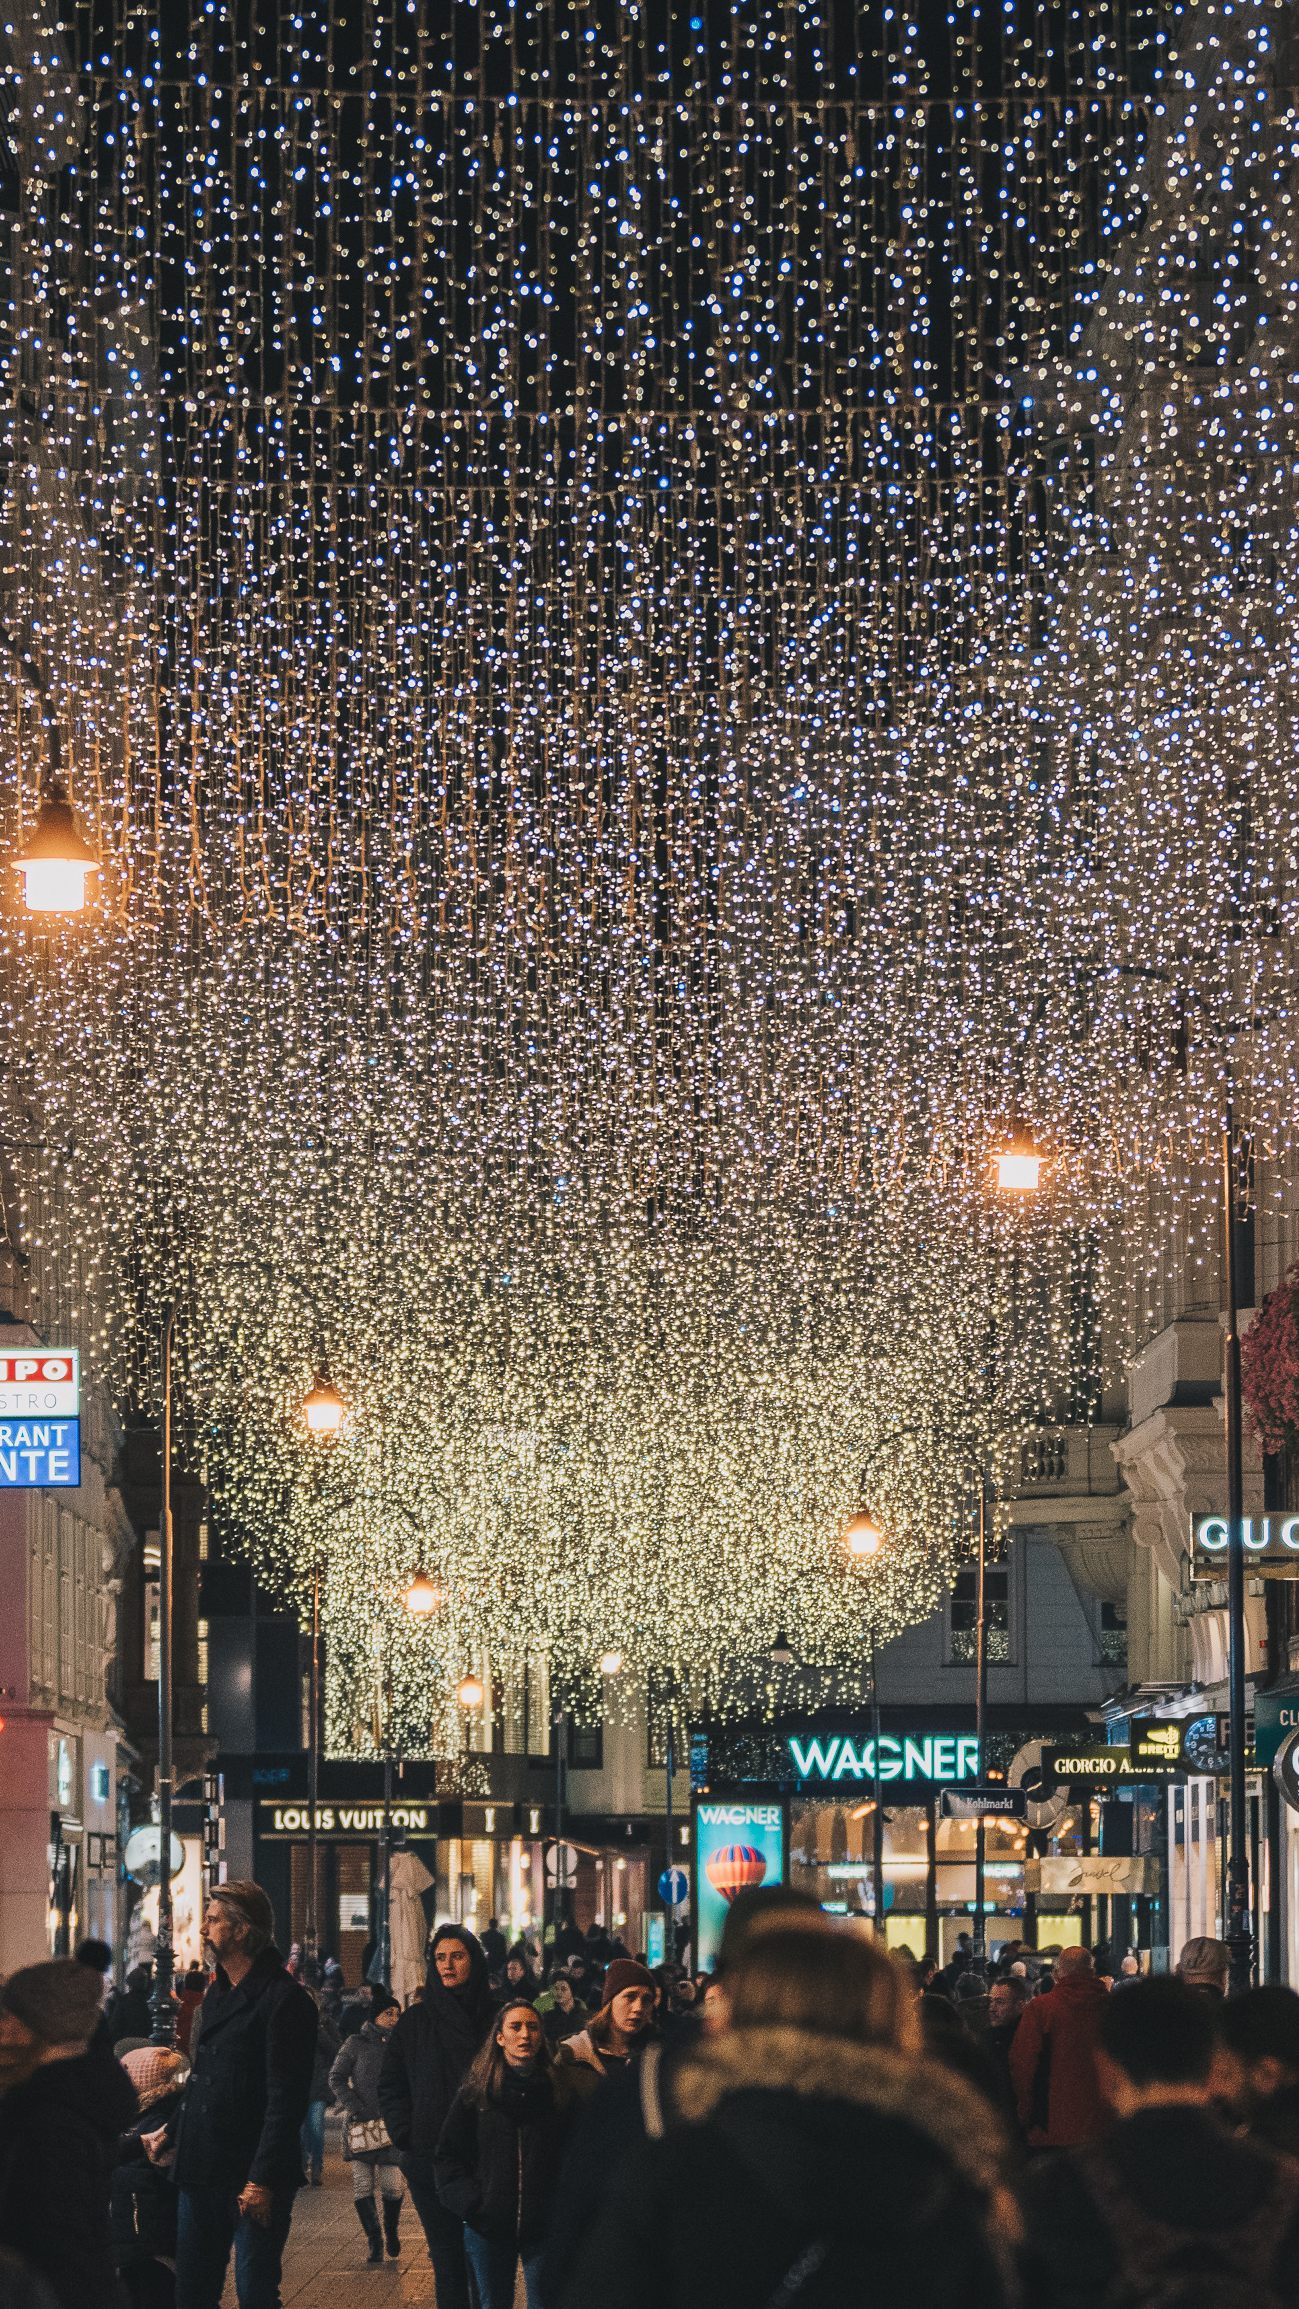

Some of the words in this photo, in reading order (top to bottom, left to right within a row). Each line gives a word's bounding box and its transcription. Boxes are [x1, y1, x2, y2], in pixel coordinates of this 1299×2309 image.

[0, 1359, 68, 1381] PO
[790, 1738, 978, 1780] WAGNER
[1054, 1758, 1116, 1774] GIORGIO
[966, 1797, 1014, 1809] Kohlmarkt
[338, 1809, 427, 1829] VUITON
[700, 1806, 780, 1825] WAGNER
